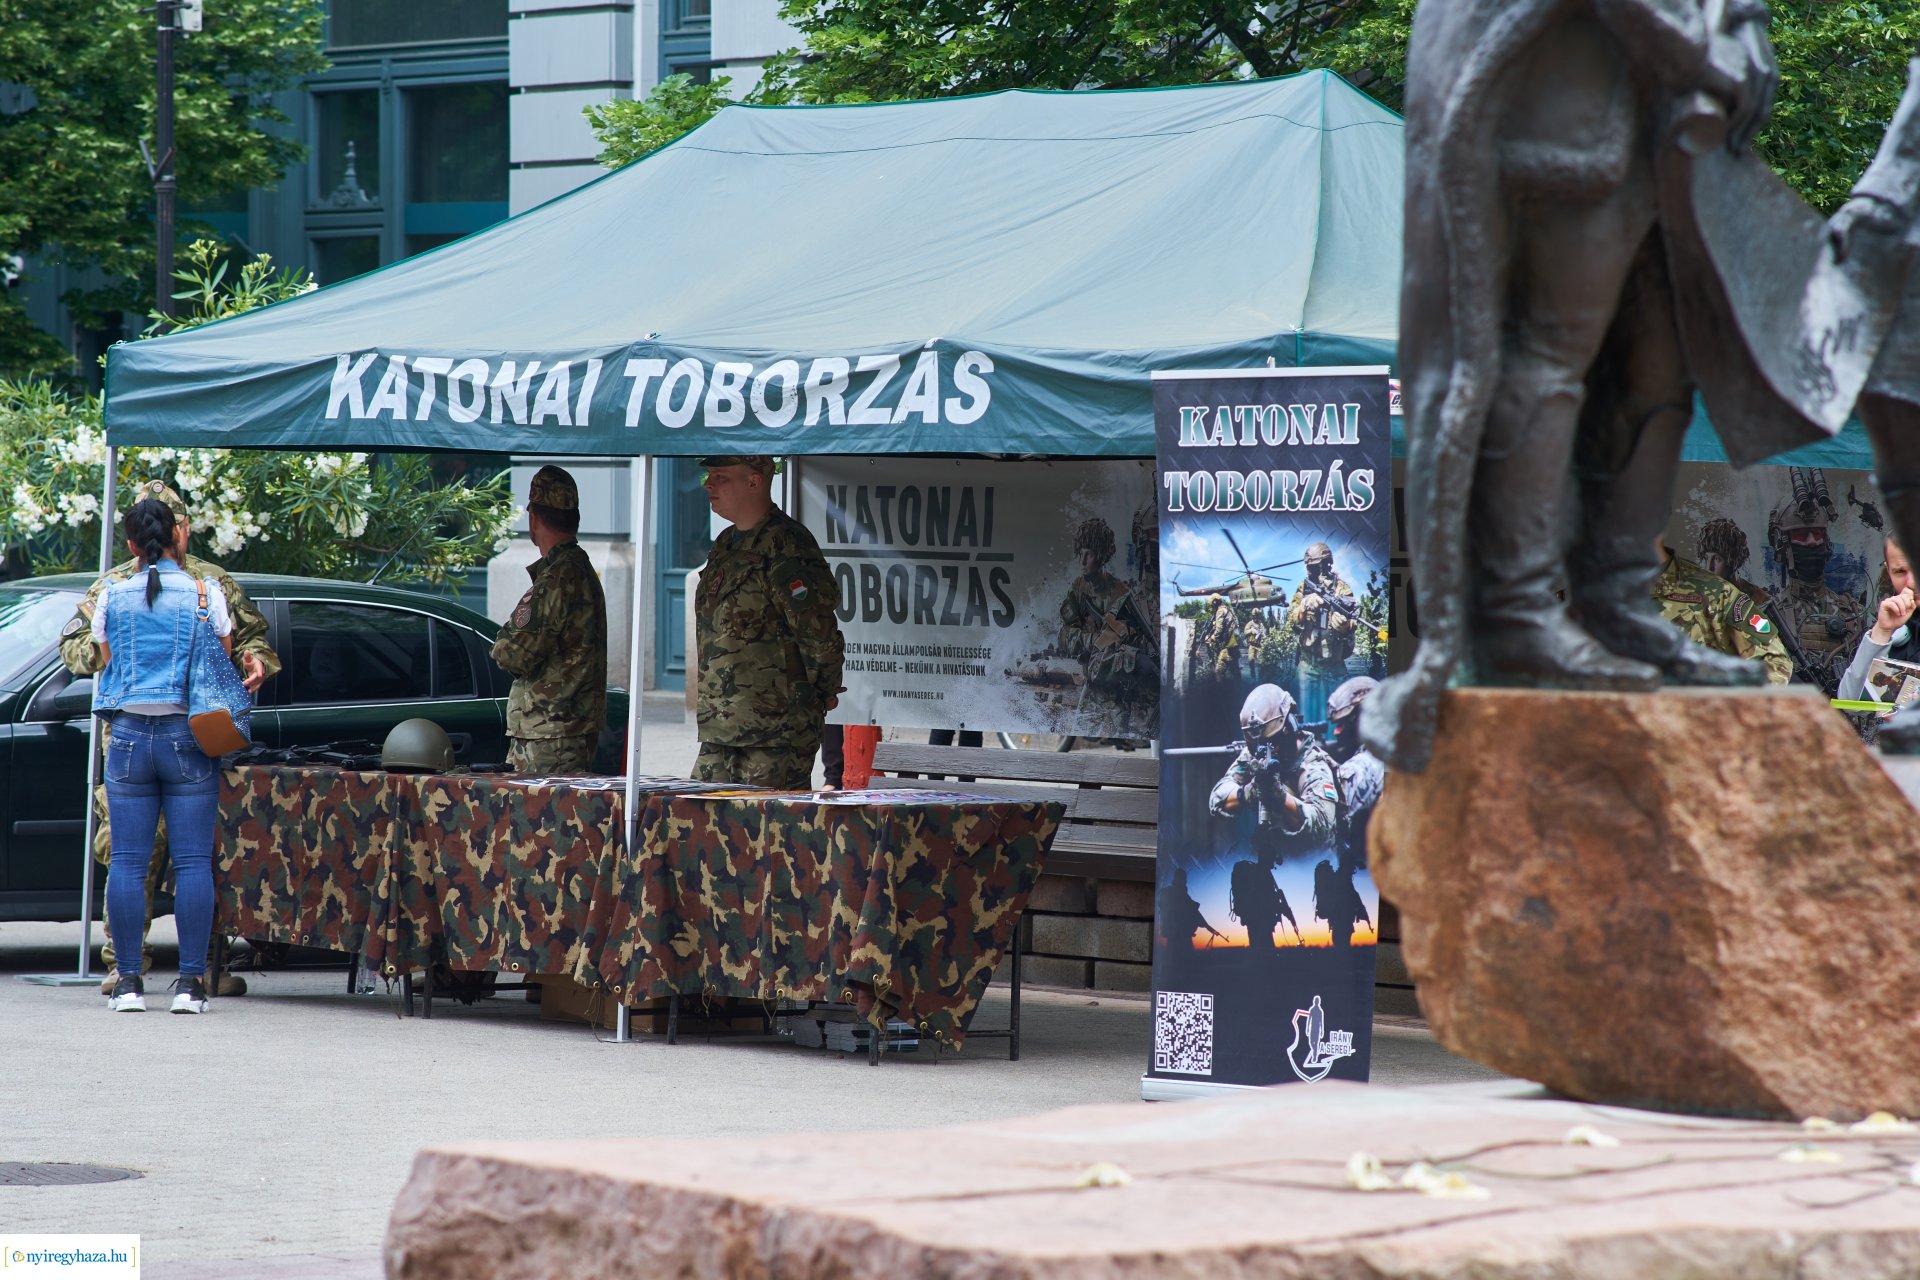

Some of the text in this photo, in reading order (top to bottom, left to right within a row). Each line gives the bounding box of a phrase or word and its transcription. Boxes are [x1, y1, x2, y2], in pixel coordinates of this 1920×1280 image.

[324, 338, 994, 428] KATONAI TOBORZÁS
[1178, 403, 1361, 447] KATONAI
[1164, 459, 1375, 512] TOBORZÁS
[826, 485, 994, 547] KATONAI
[826, 562, 1015, 628] OBORZÁS
[844, 641, 992, 659] DEN MAGYAR ÁLLAMPOLGÁR KÖTELESSÉGE
[845, 659, 865, 672] HAZA
[866, 658, 897, 673] VÉDELME
[905, 660, 934, 675] NEKÜNK
[935, 664, 941, 675] A
[942, 662, 986, 677] HIVATÁSUNK
[1330, 1030, 1353, 1044] IRÁNY
